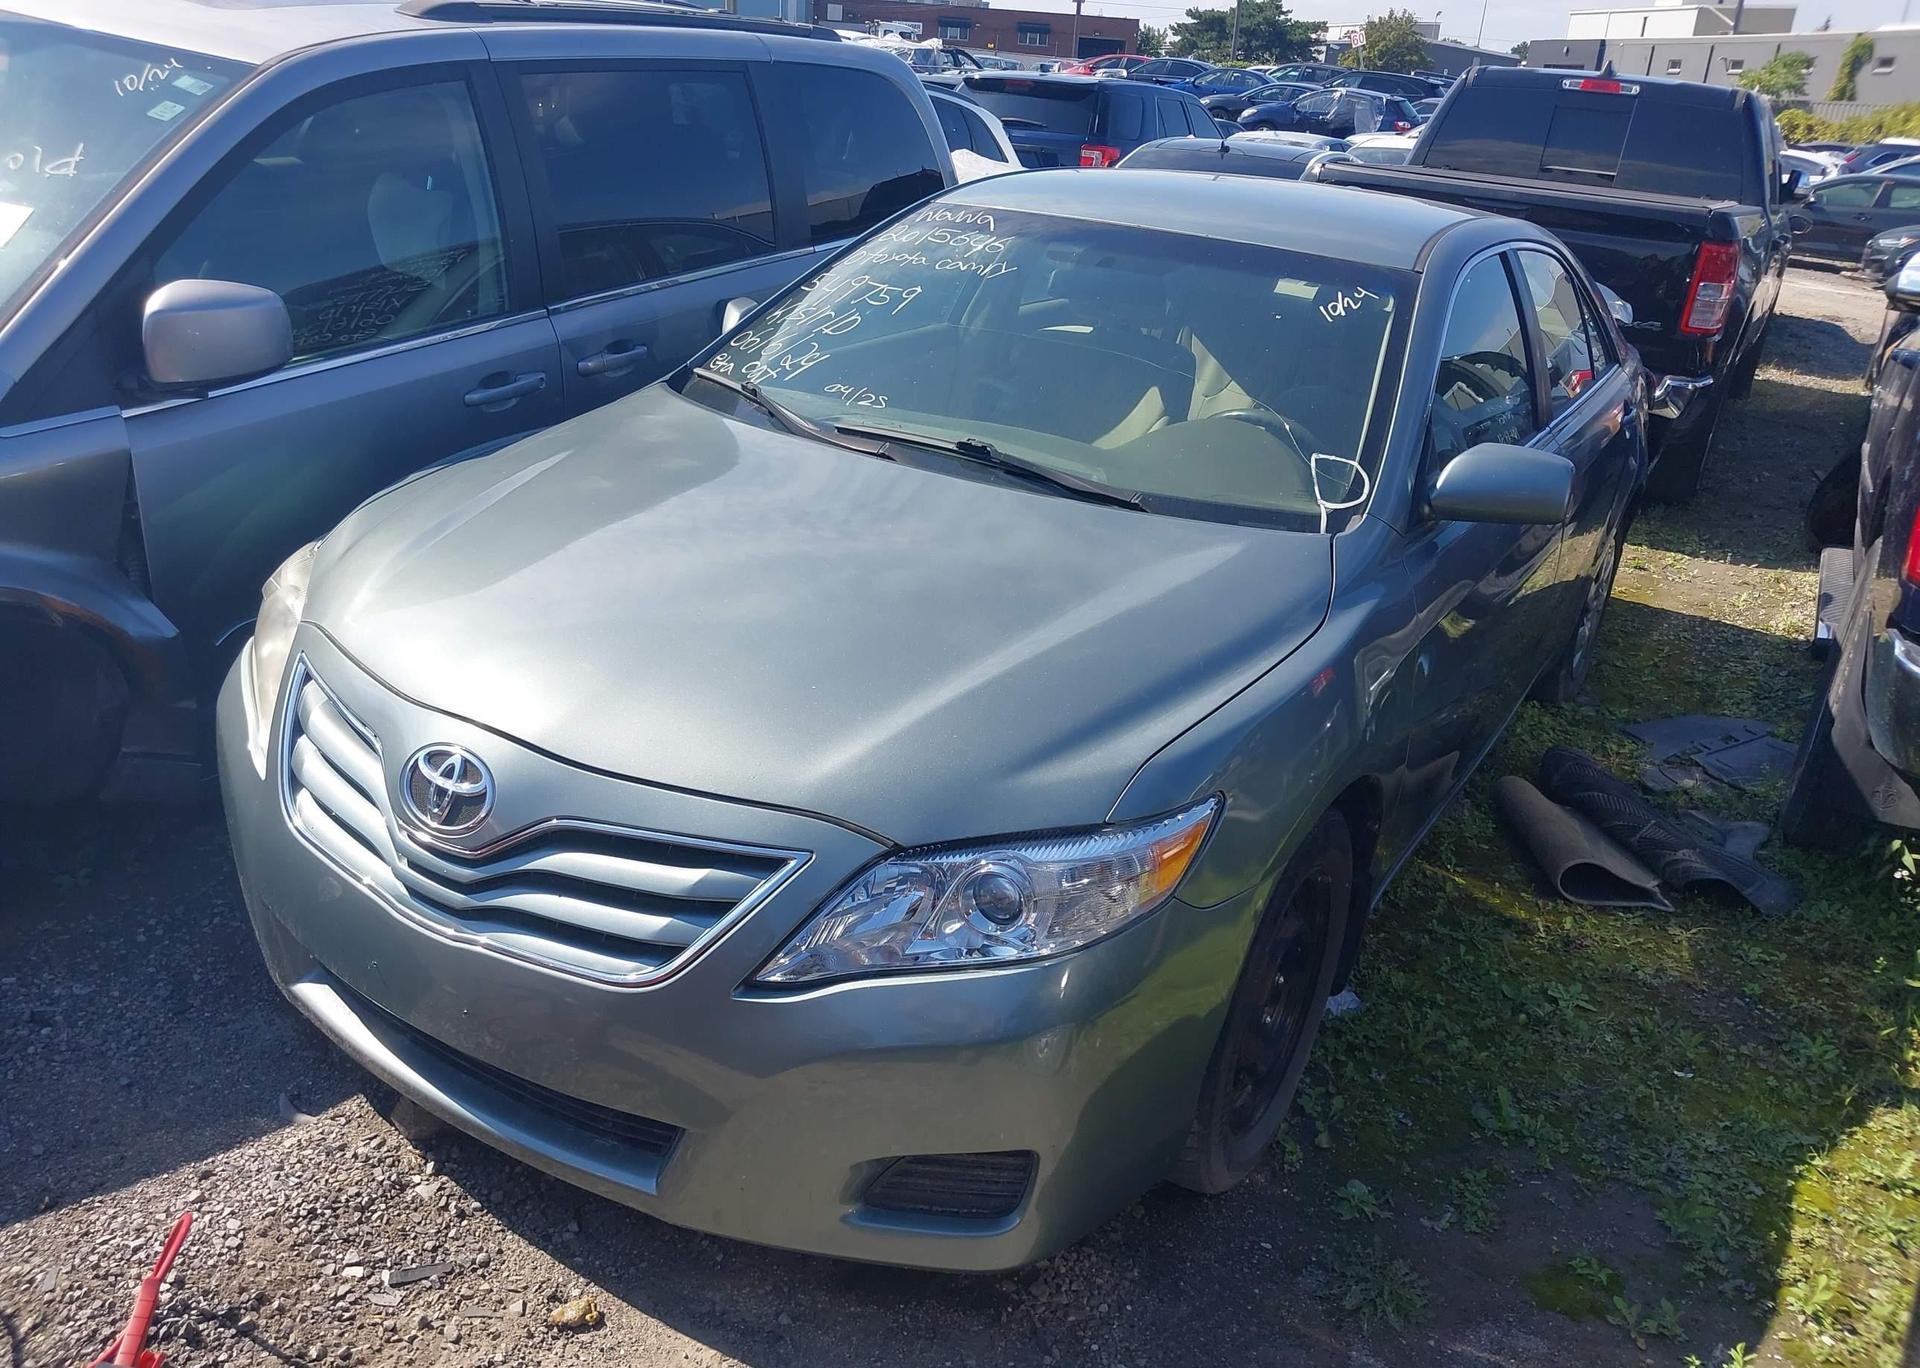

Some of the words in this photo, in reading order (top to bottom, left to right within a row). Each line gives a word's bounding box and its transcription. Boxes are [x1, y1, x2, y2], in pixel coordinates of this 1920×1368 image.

[1352, 32, 1365, 46] 60
[113, 57, 184, 97] 10/24
[1318, 285, 1380, 323] 10/24
[823, 383, 889, 409] 04/25
